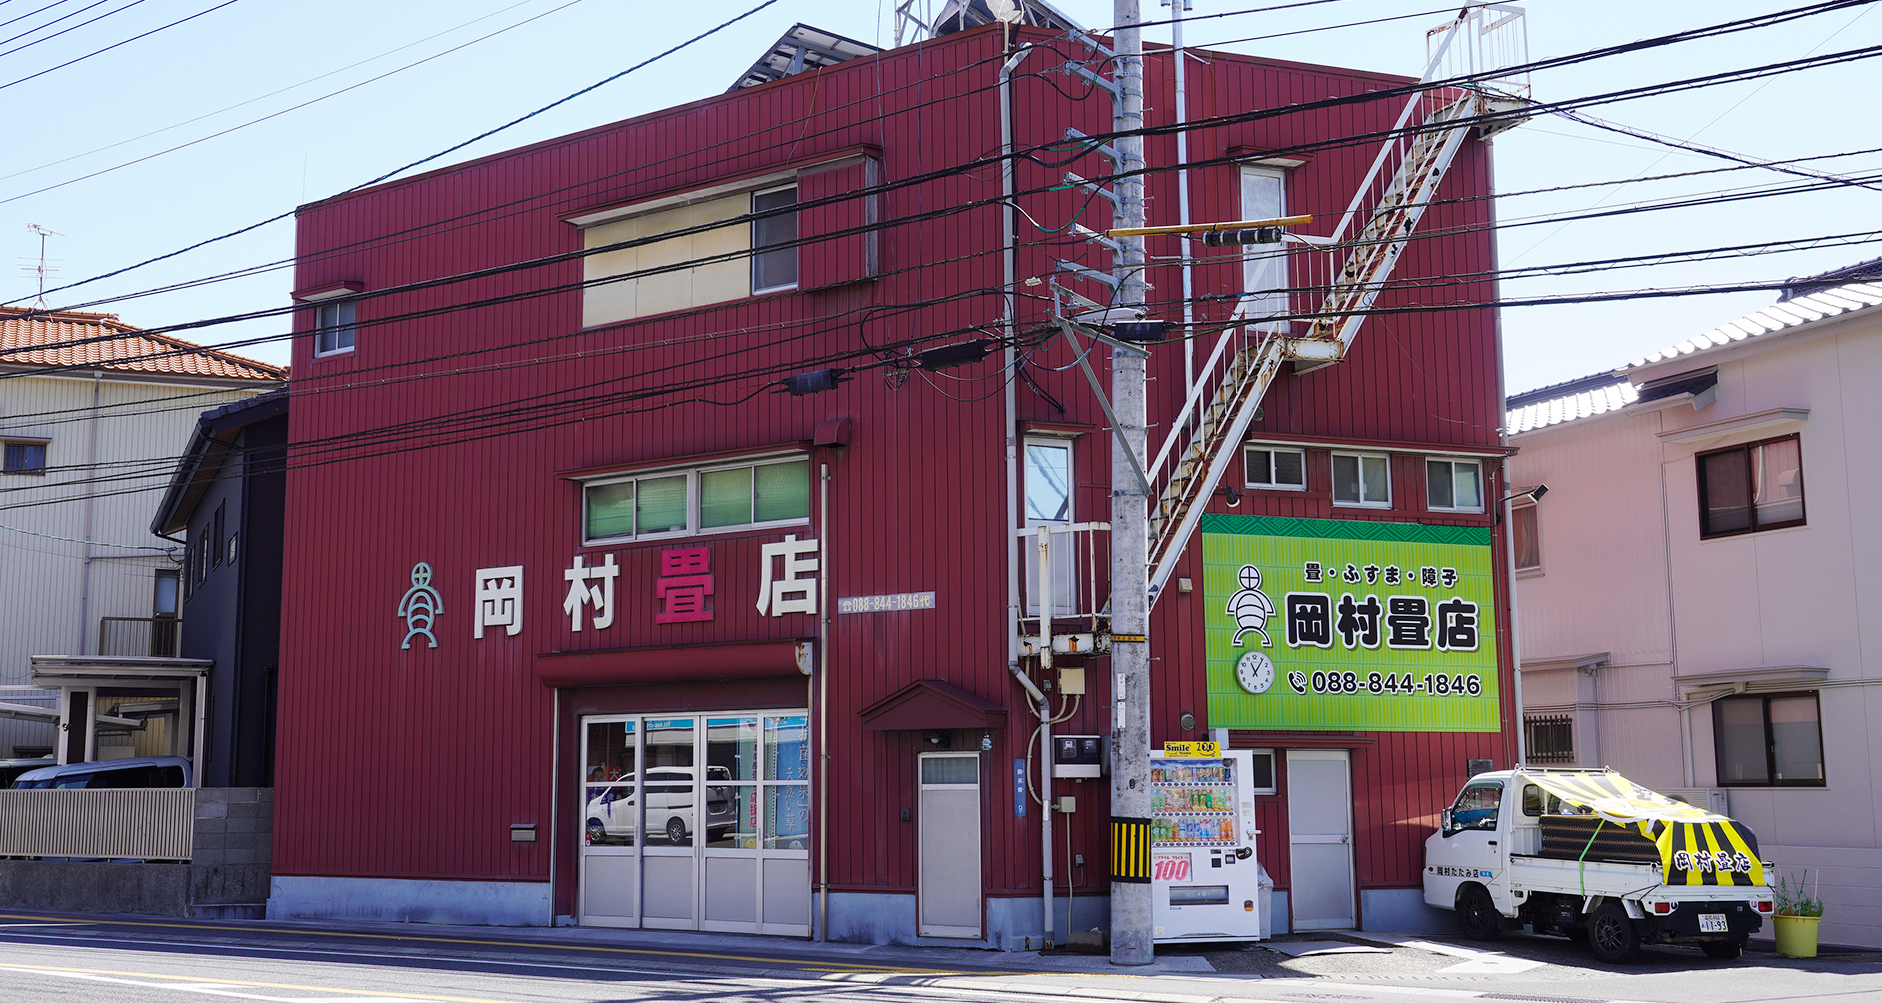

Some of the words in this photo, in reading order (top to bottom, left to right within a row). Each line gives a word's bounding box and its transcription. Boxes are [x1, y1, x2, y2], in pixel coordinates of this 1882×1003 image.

[474, 534, 819, 639] 岡村畳店
[1304, 561, 1458, 588] 畳・ふすま・障子
[1286, 592, 1479, 650] 岡村畳店
[1311, 670, 1481, 696] 088-844-1846
[1154, 860, 1189, 881] 100
[1437, 866, 1479, 878] 岡村たたみ店
